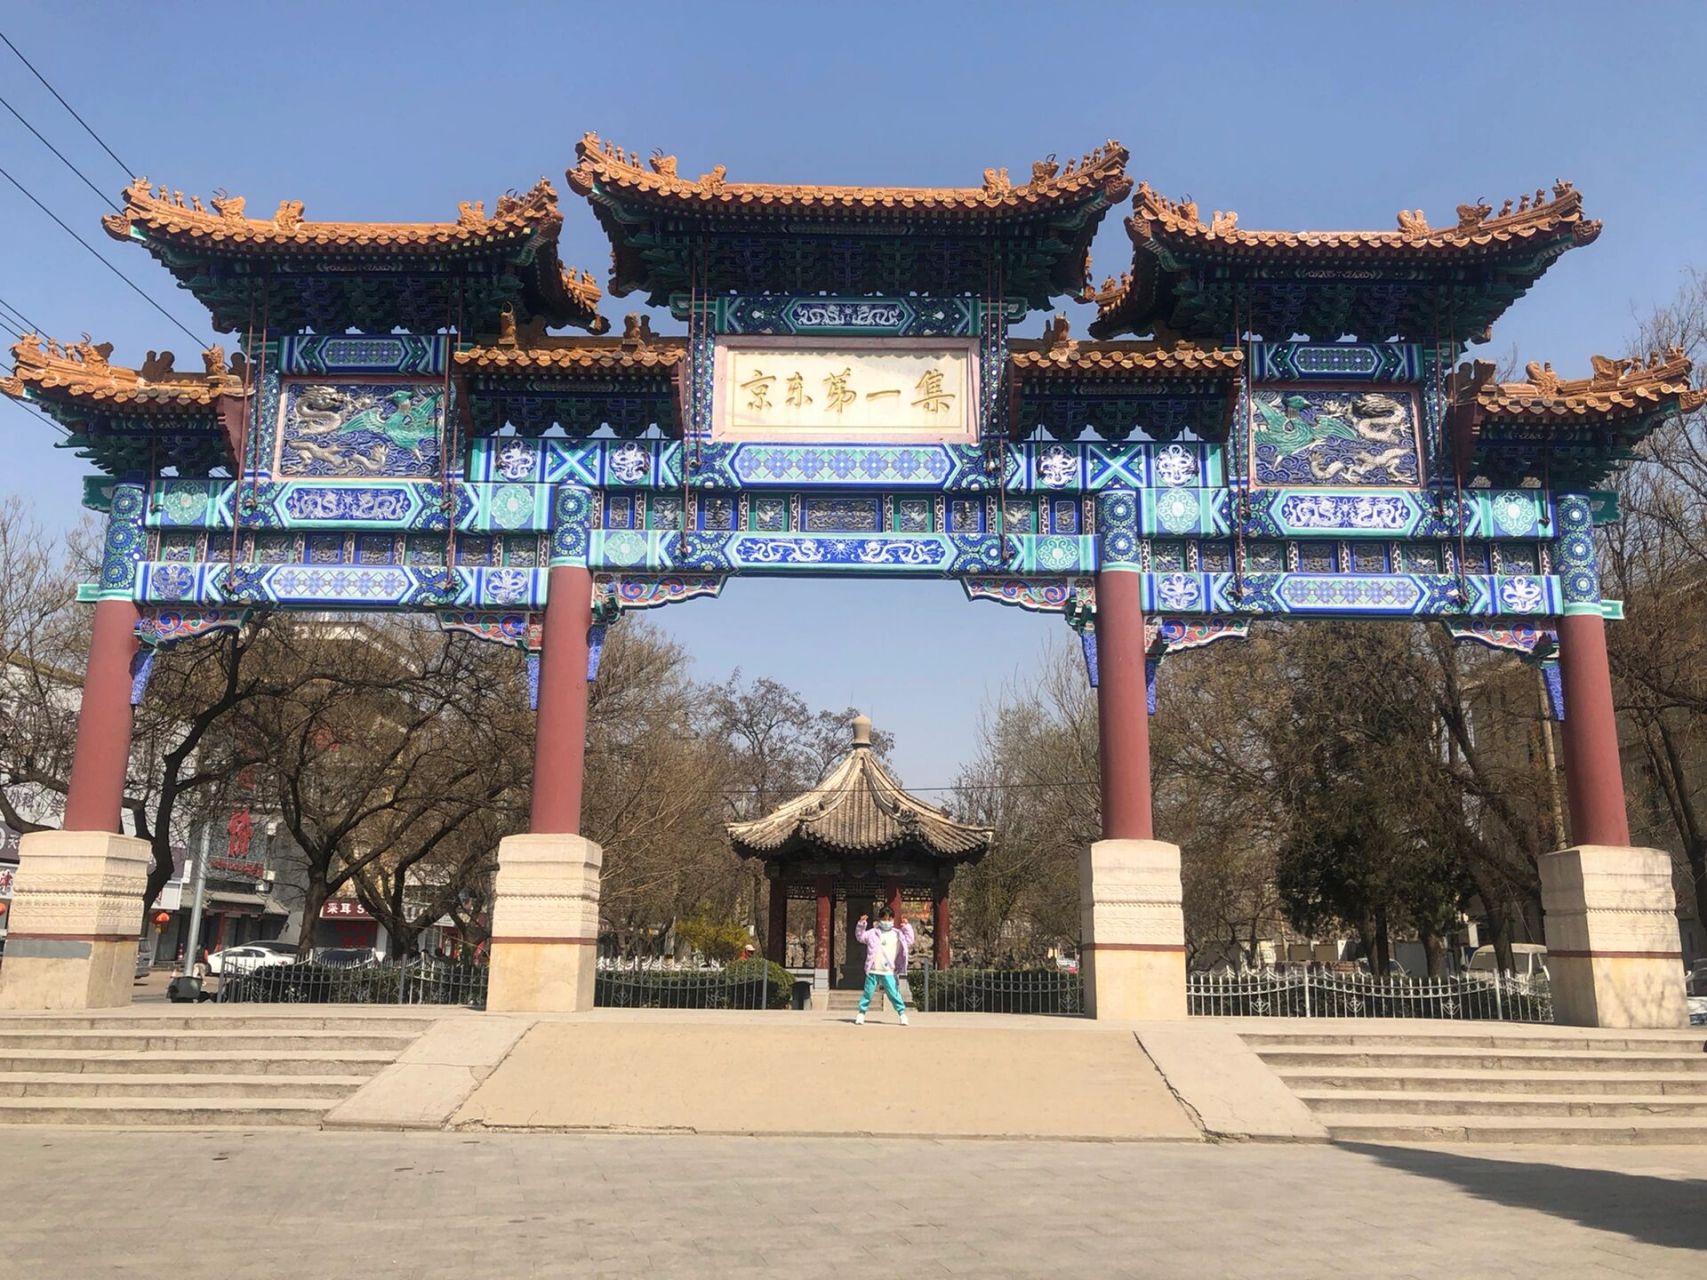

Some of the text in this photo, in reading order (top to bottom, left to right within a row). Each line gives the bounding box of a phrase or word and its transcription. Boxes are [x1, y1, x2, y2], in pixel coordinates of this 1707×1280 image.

[740, 367, 956, 414] 京东第一集
[327, 902, 352, 915] 采耳
